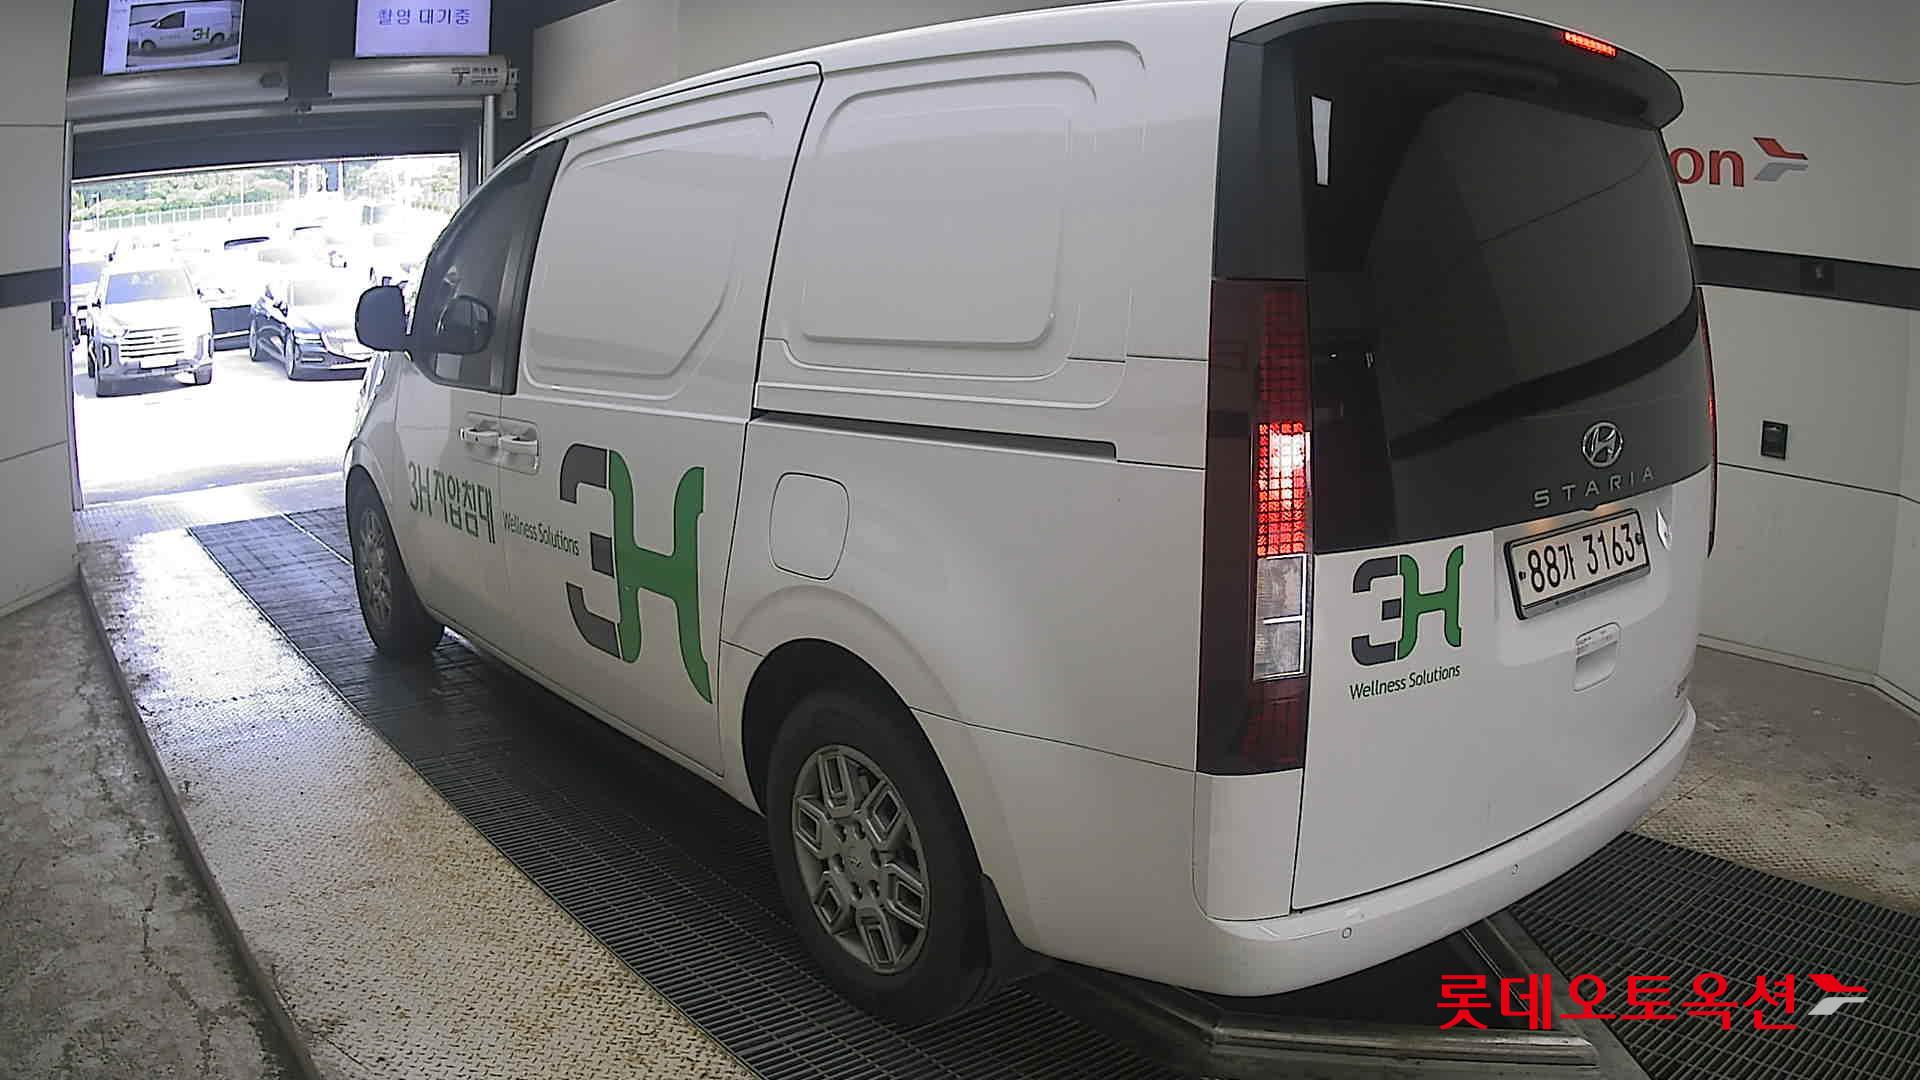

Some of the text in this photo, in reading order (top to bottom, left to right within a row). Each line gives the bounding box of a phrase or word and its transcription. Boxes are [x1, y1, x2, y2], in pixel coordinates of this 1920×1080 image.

[418, 8, 471, 26] 대기중
[408, 460, 496, 545] 3H 지압침대
[1533, 465, 1655, 508] STARIA
[502, 510, 580, 557] Wellness Solutions
[1527, 522, 1636, 593] 88가 3163
[560, 442, 713, 705] 3H
[1351, 544, 1464, 666] 3H
[1349, 664, 1461, 701] Wellness Solutions
